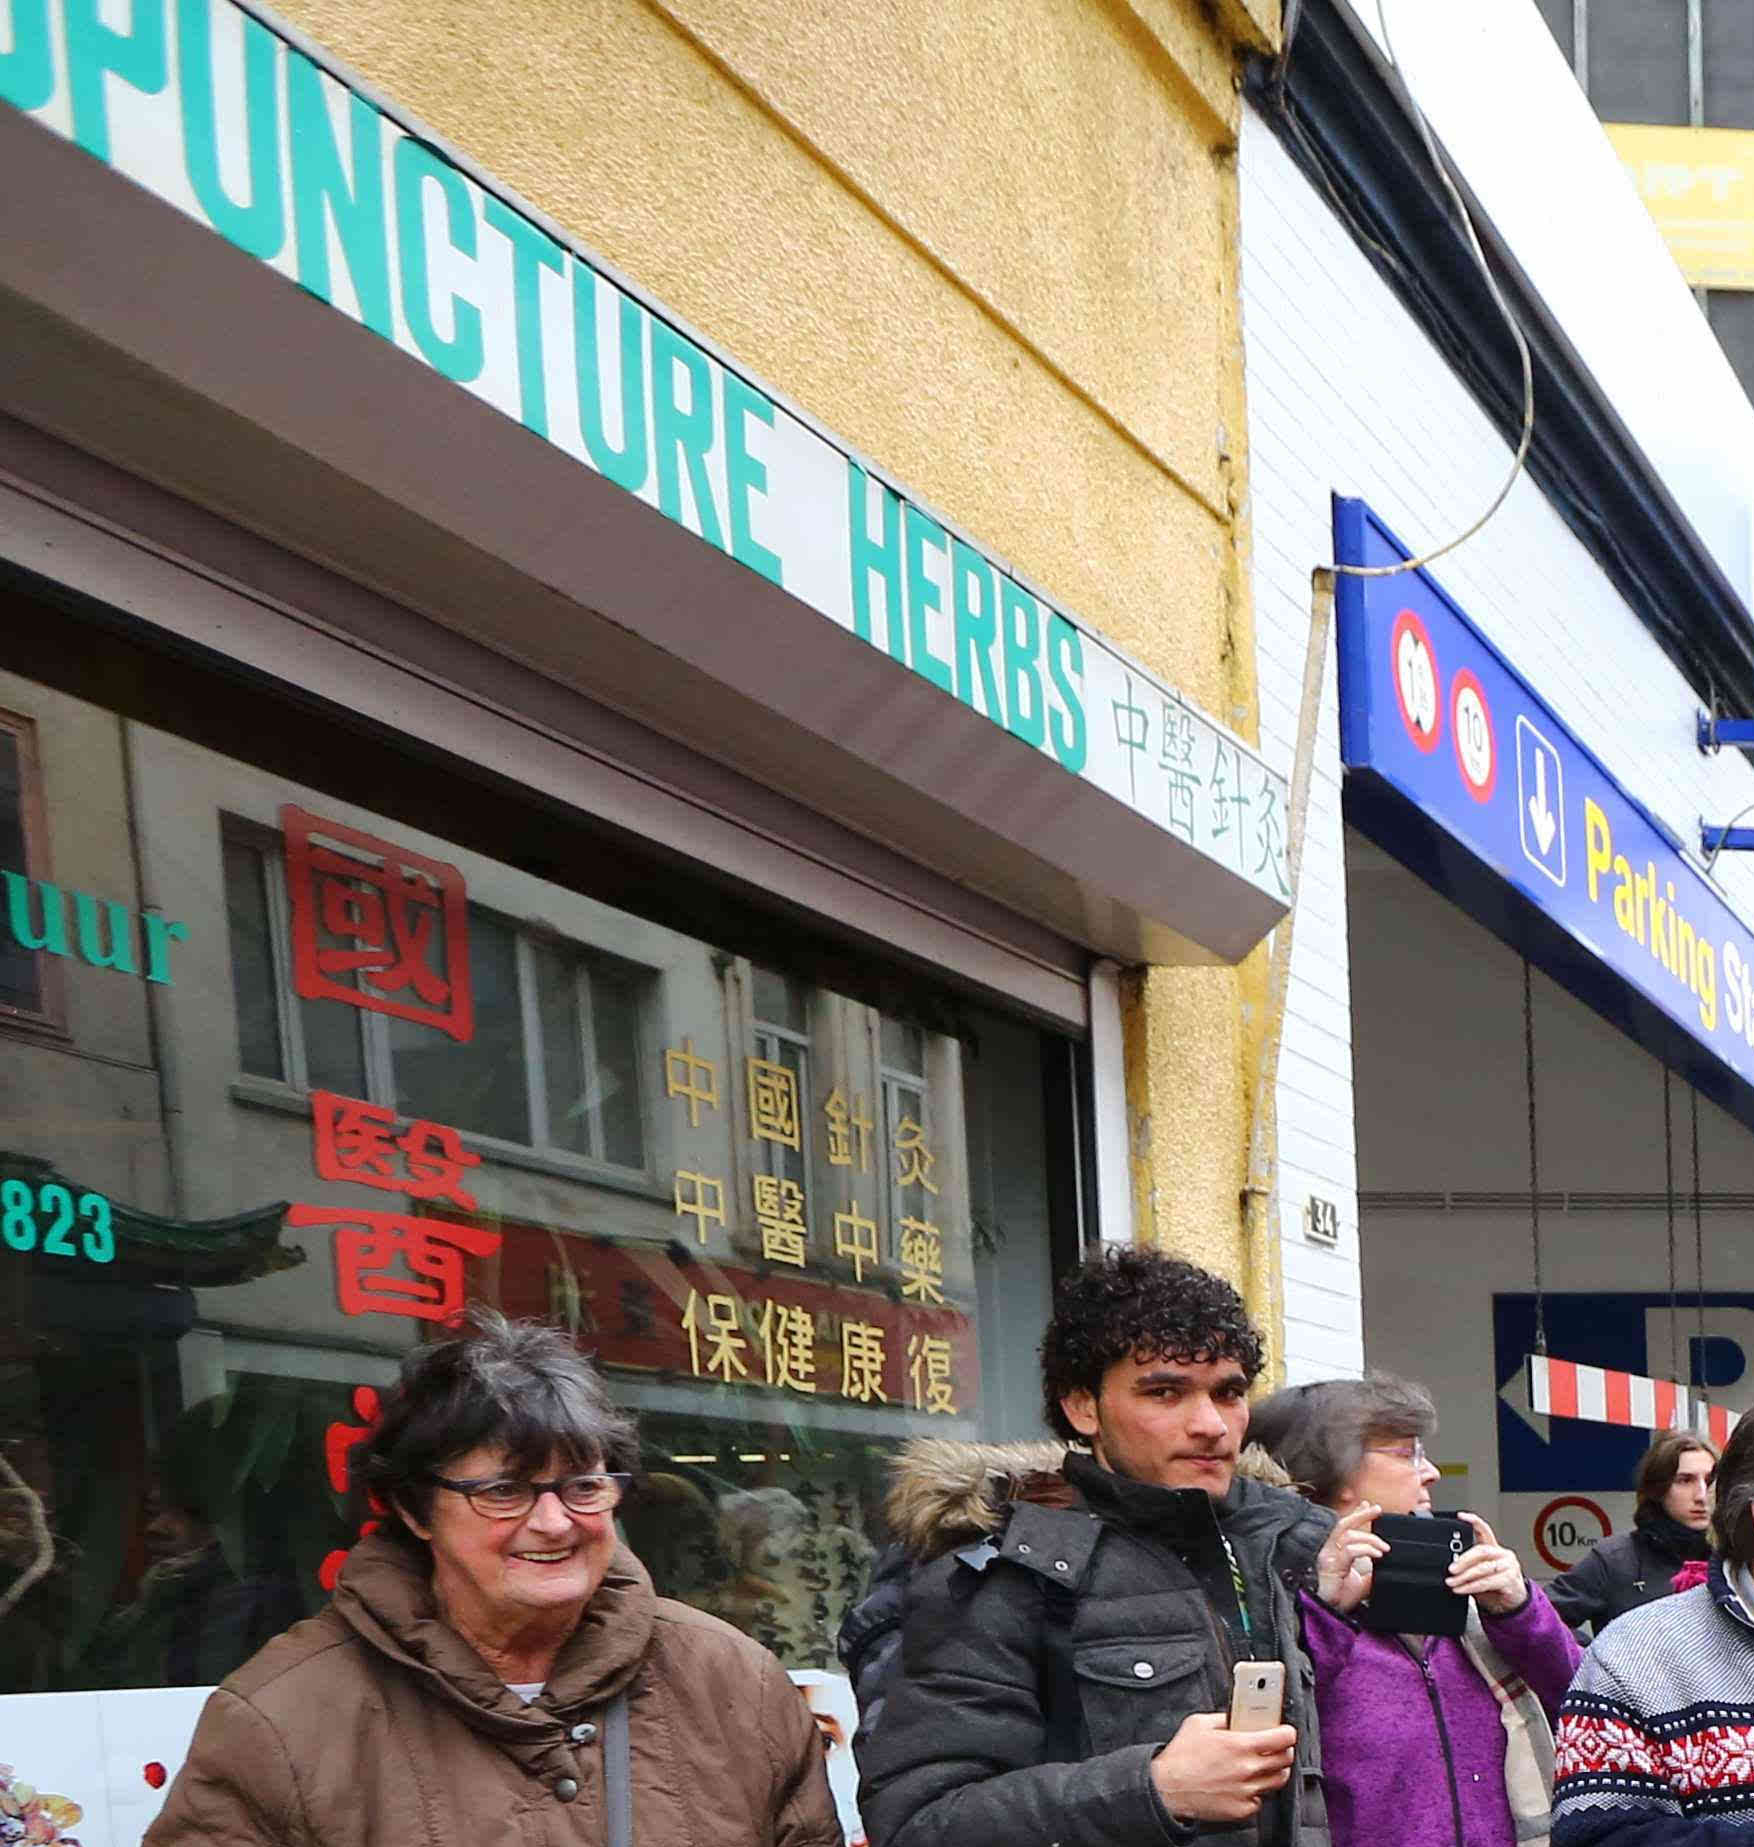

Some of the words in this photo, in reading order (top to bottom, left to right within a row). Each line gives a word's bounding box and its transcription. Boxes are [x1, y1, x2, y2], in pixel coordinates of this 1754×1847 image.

[0, 0, 784, 590] PUNCTURE
[847, 455, 1088, 777] HERBS
[1109, 672, 1292, 898] 中醫針灸
[1583, 796, 1719, 1032] Parking
[665, 1039, 940, 1196] 中國針灸
[0, 1178, 116, 1264] 823
[673, 1169, 945, 1306] 中醫中藥
[681, 1288, 958, 1417] 保健康復
[1547, 1521, 1577, 1547] 10
